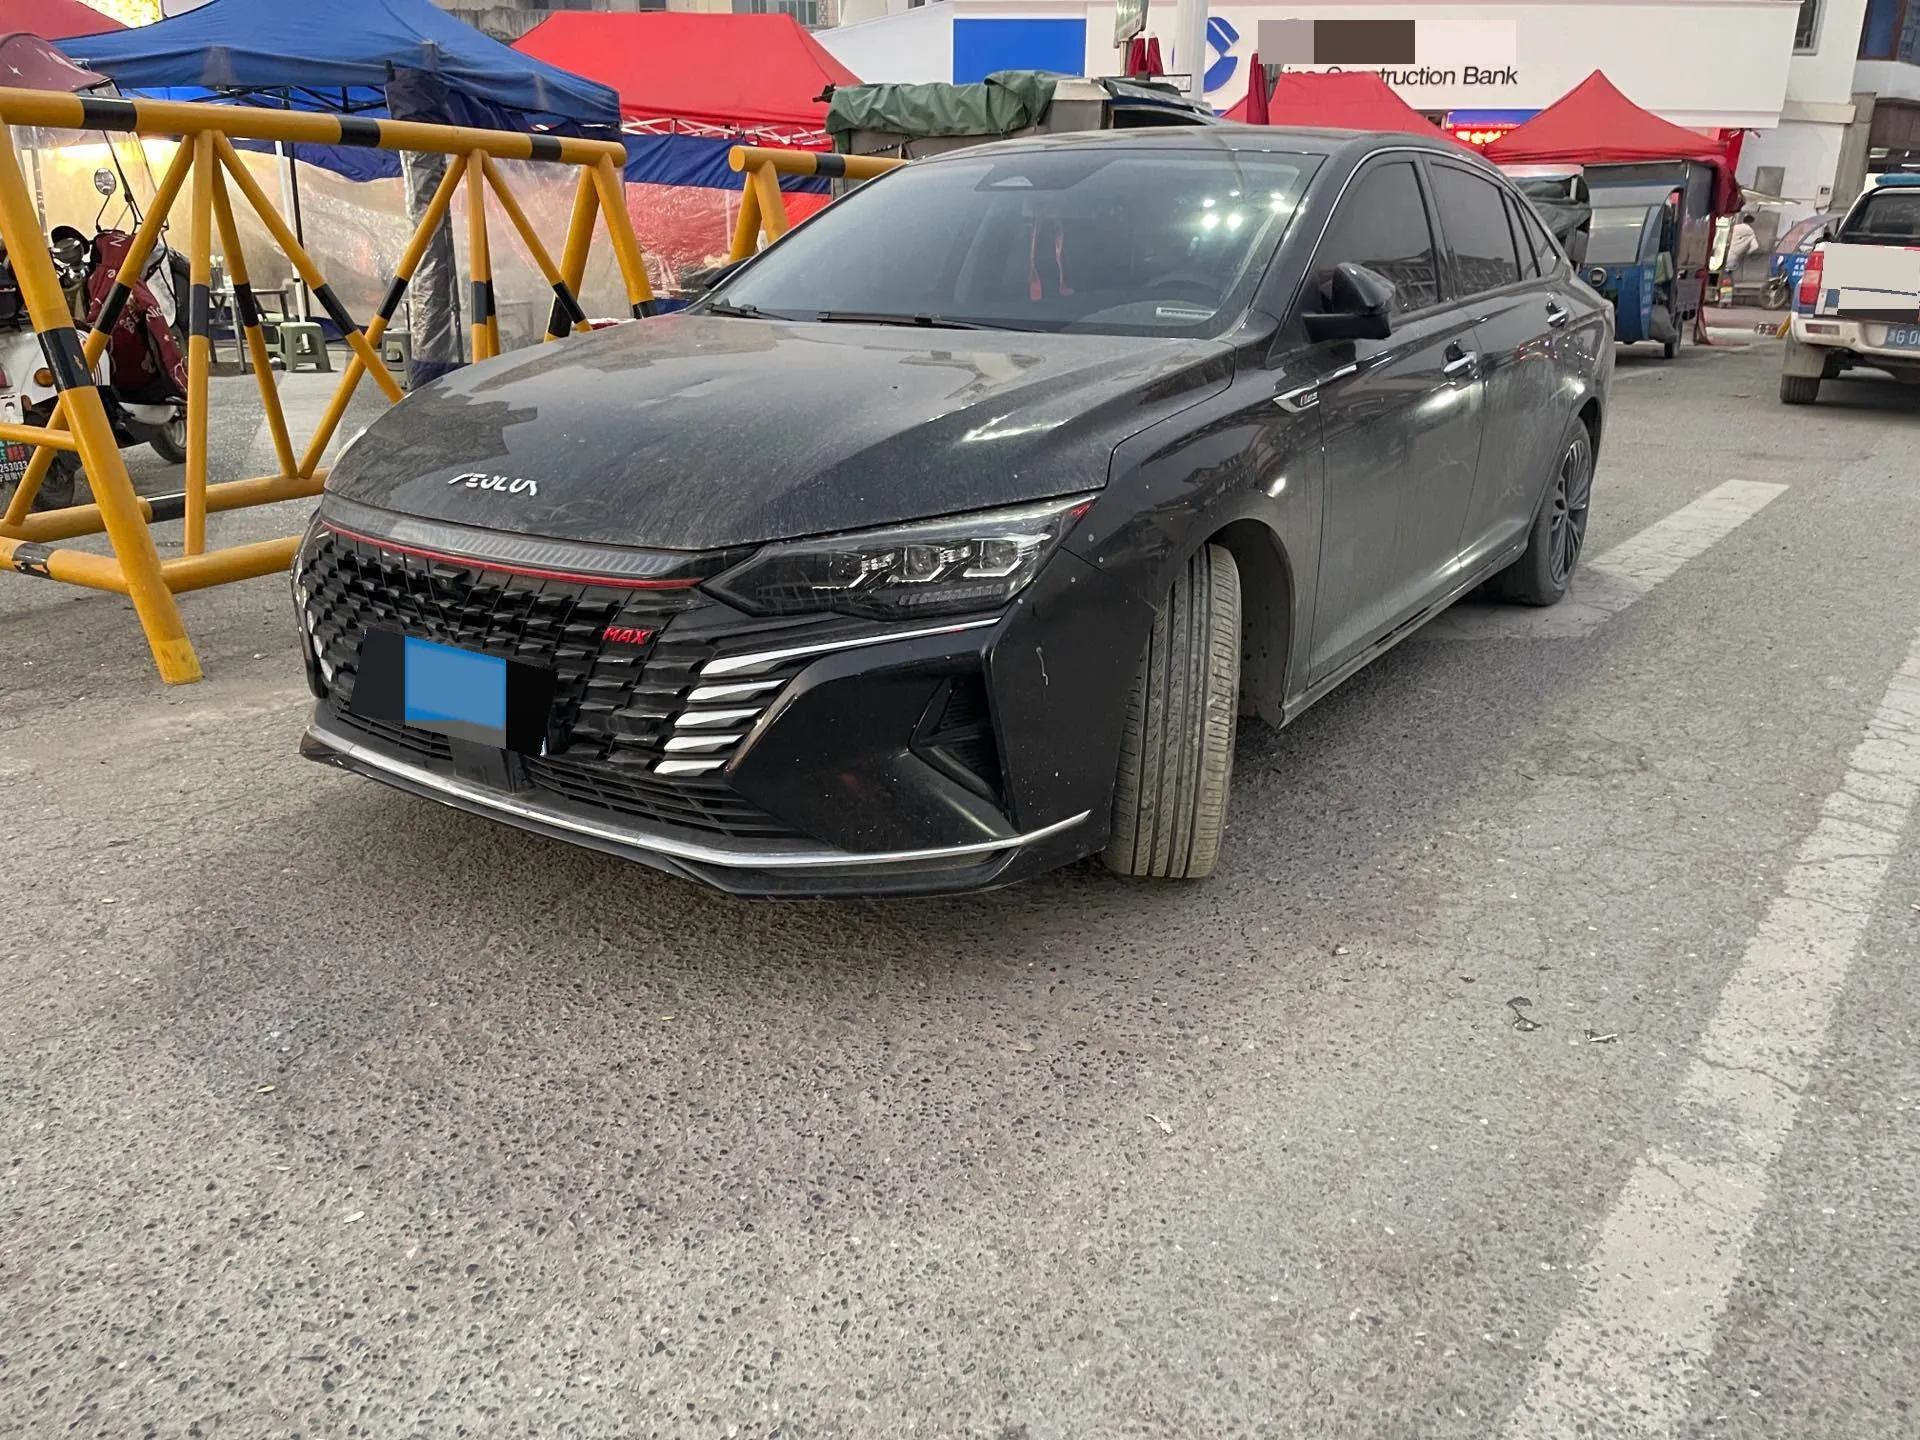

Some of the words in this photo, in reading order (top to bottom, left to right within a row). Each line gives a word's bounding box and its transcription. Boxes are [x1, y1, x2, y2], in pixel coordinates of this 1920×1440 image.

[1327, 66, 1455, 85] truction
[1463, 65, 1518, 85] Bank
[602, 626, 652, 645] MAX
